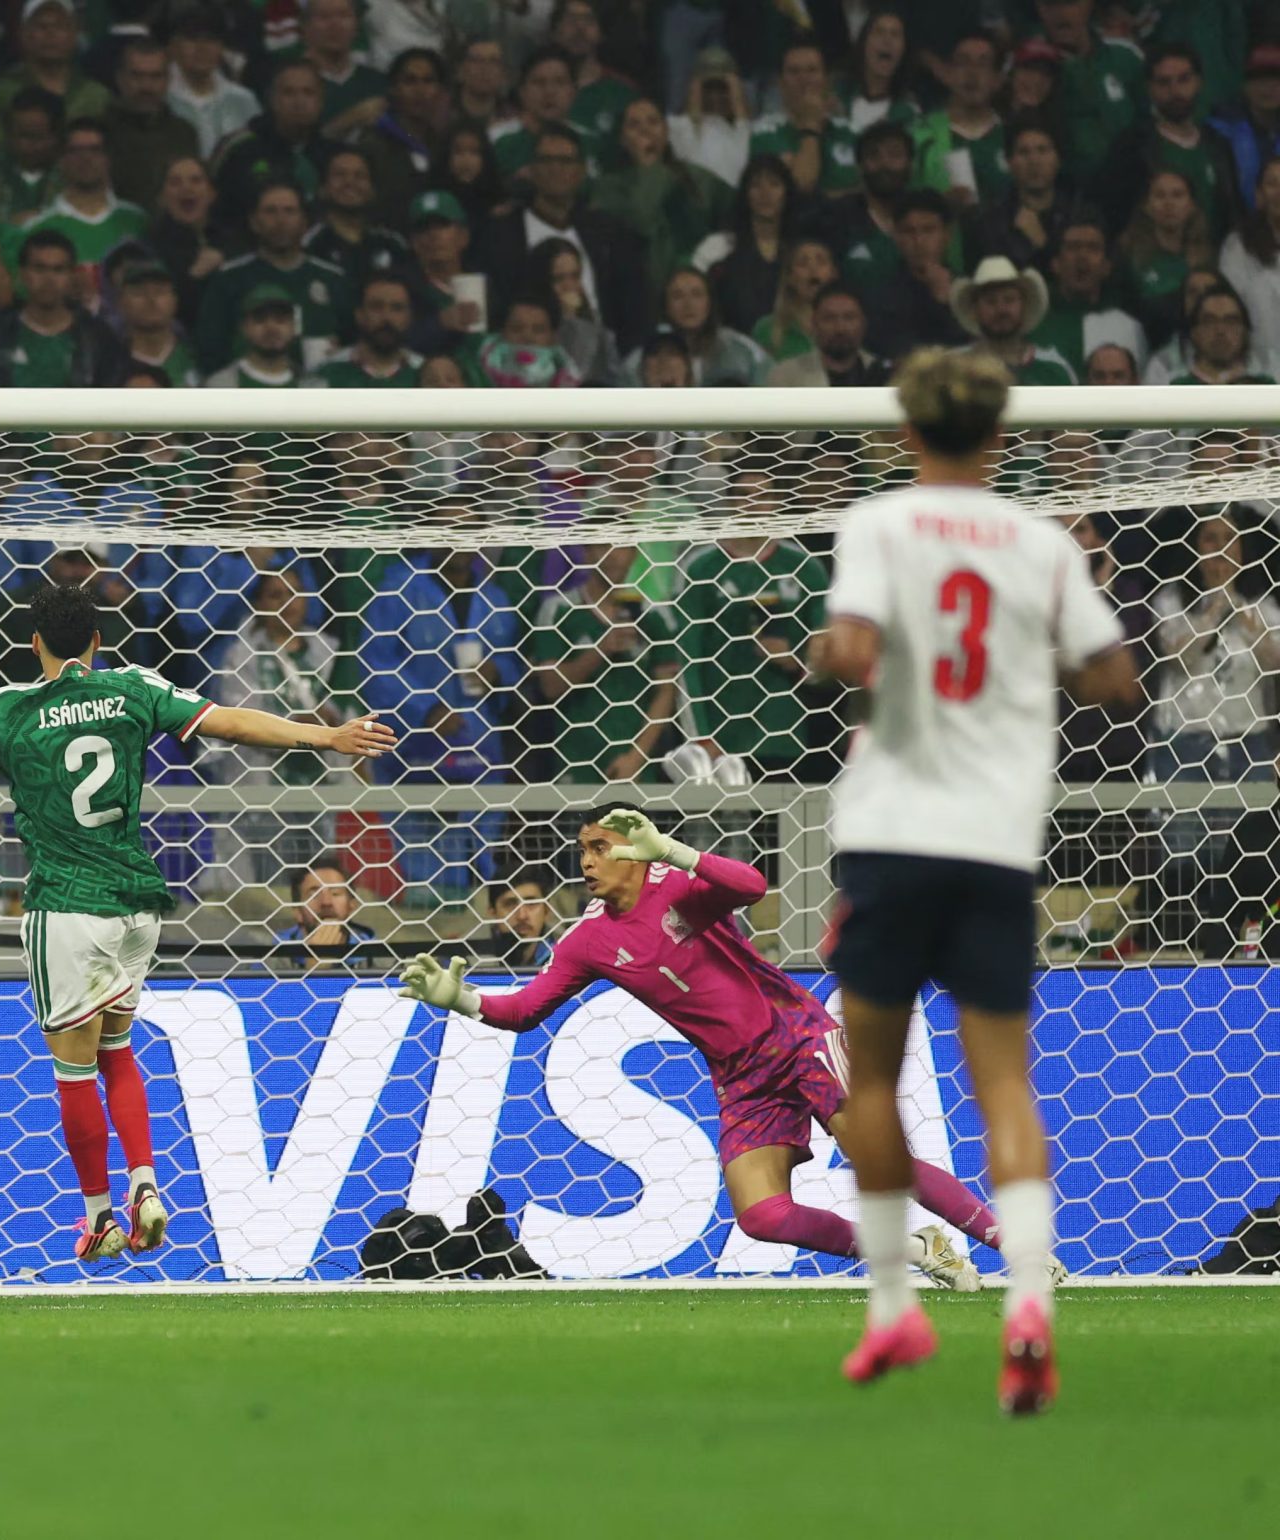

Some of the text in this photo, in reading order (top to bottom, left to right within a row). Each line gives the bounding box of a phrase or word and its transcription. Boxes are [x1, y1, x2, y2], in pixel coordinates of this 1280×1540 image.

[933, 567, 992, 704] 3
[38, 696, 127, 730] J.SÁNCHEZ
[64, 735, 124, 828] 2
[658, 966, 690, 993] 1
[132, 985, 976, 1280] VISA
